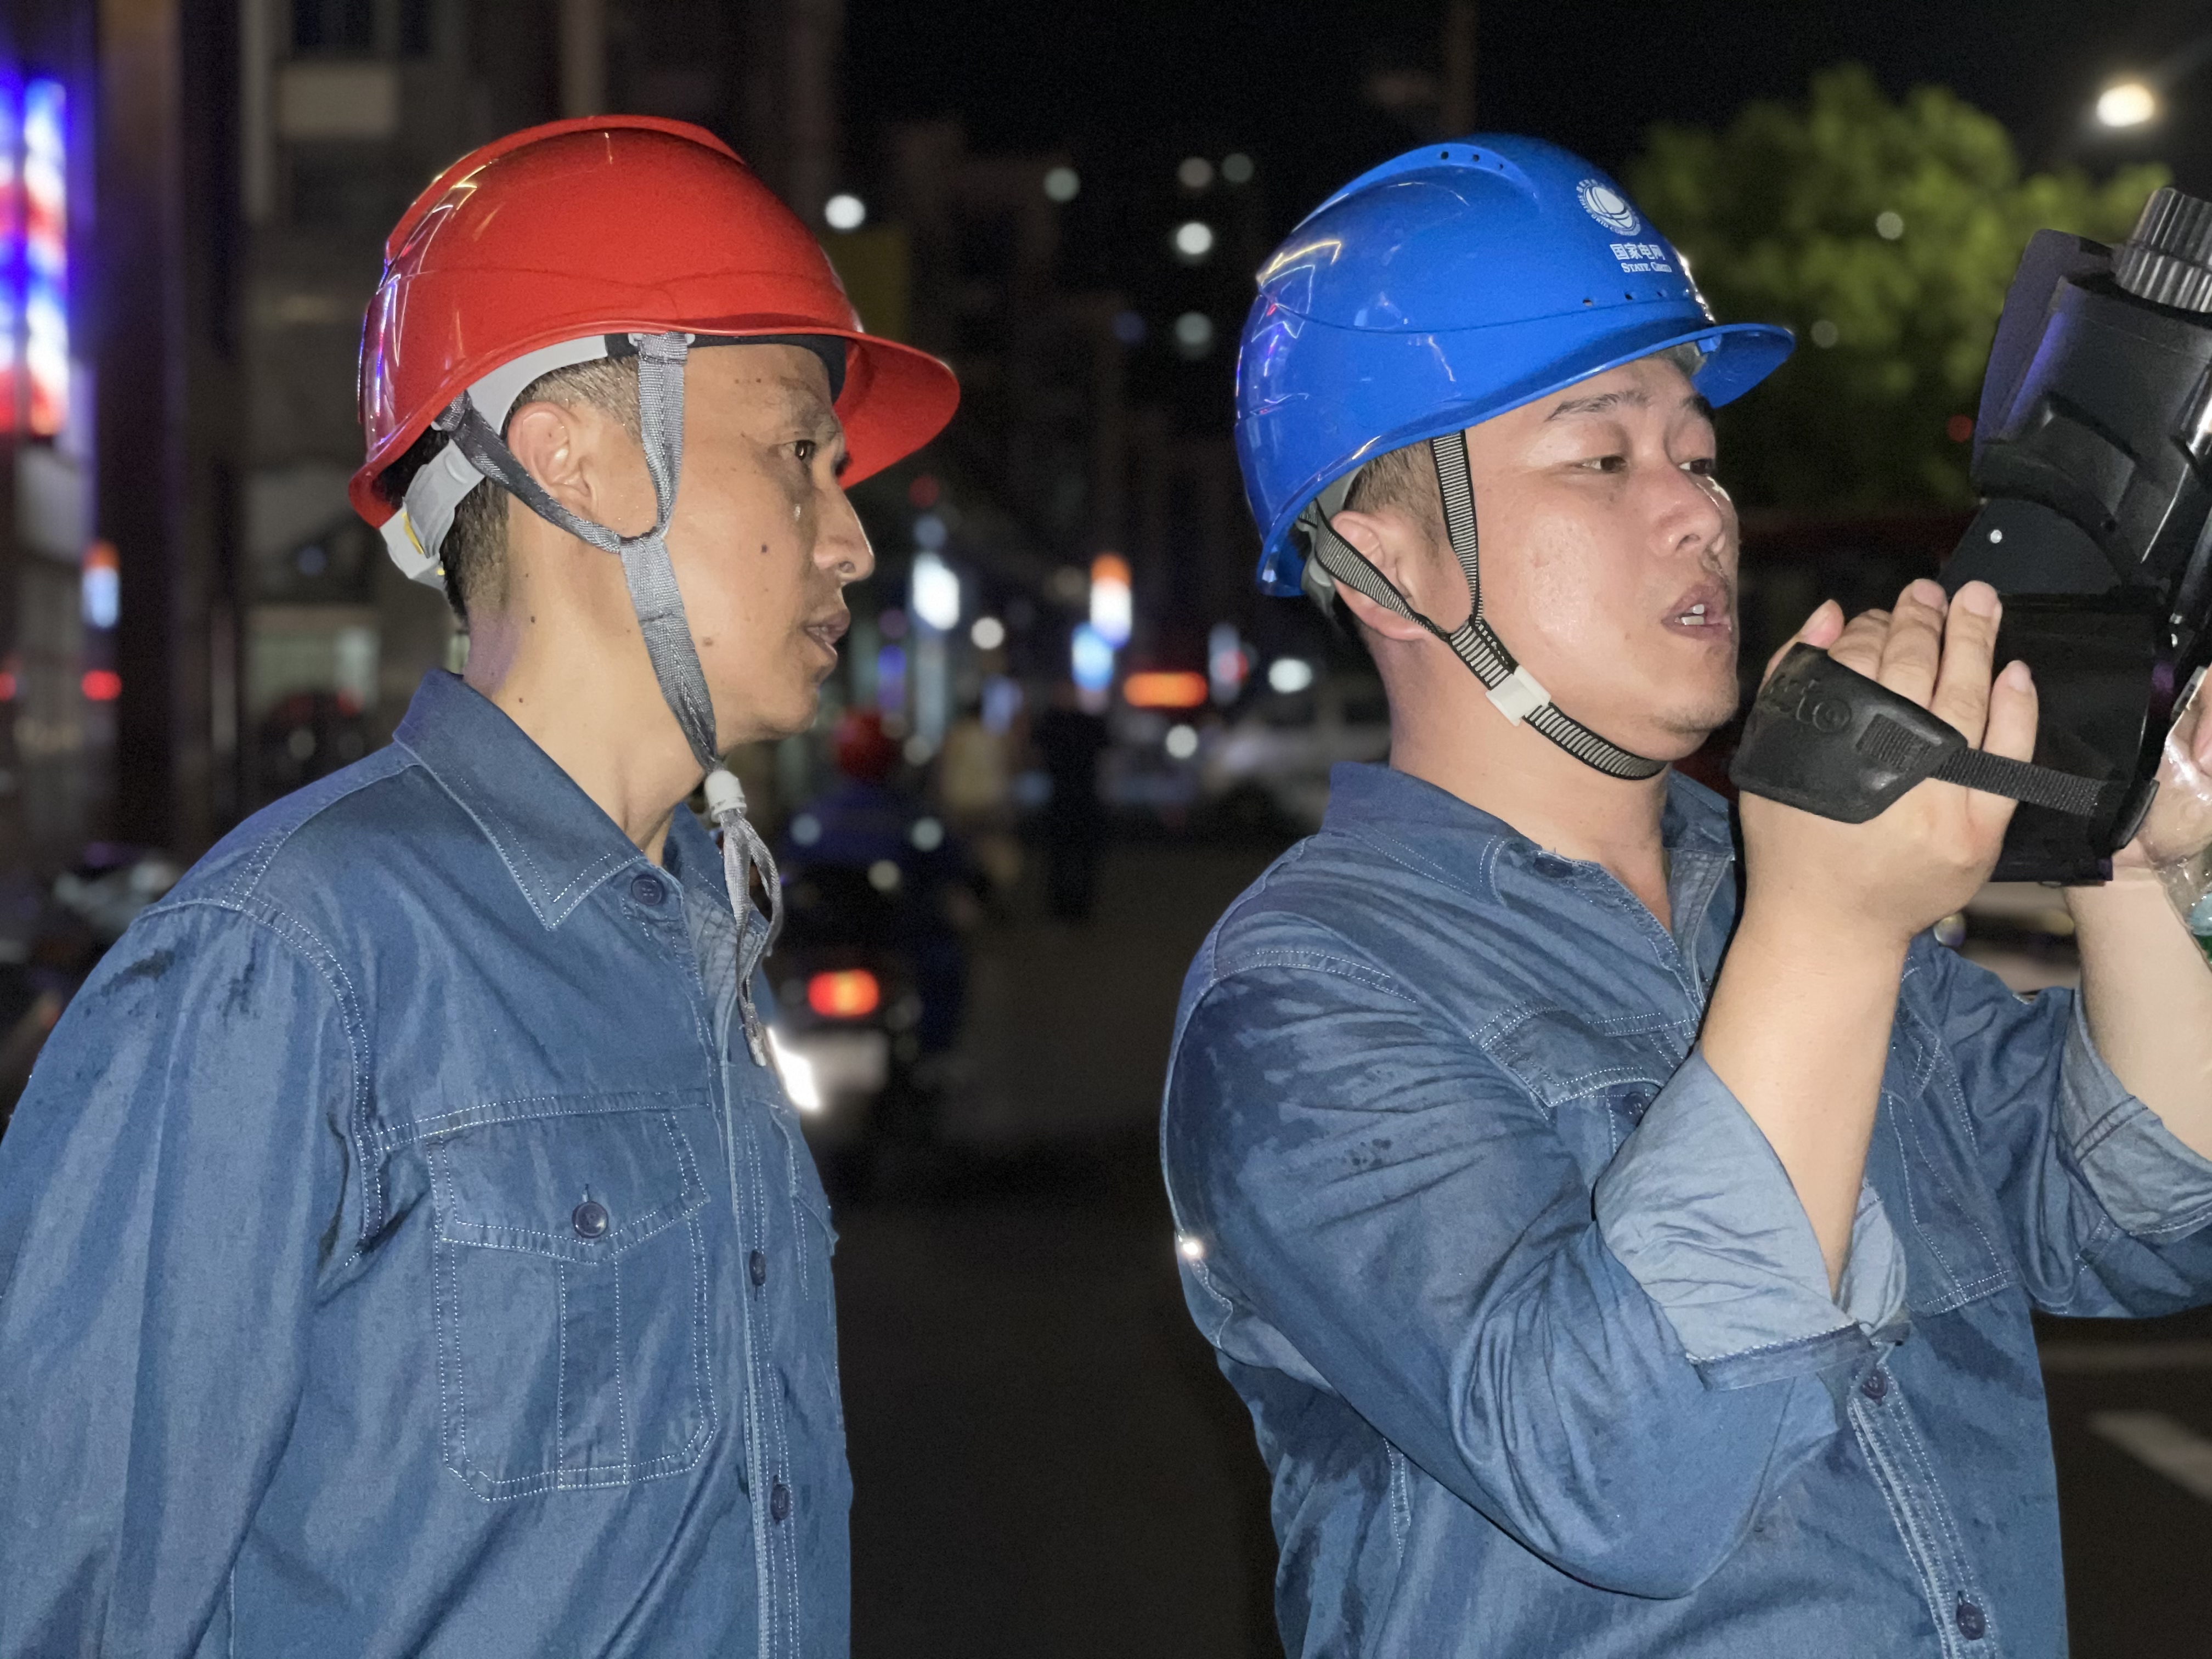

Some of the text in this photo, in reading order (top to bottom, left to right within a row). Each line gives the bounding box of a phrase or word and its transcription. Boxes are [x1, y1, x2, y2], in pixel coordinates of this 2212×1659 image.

[1609, 242, 1666, 261] 国家电网
[1621, 262, 1651, 273] STATE
